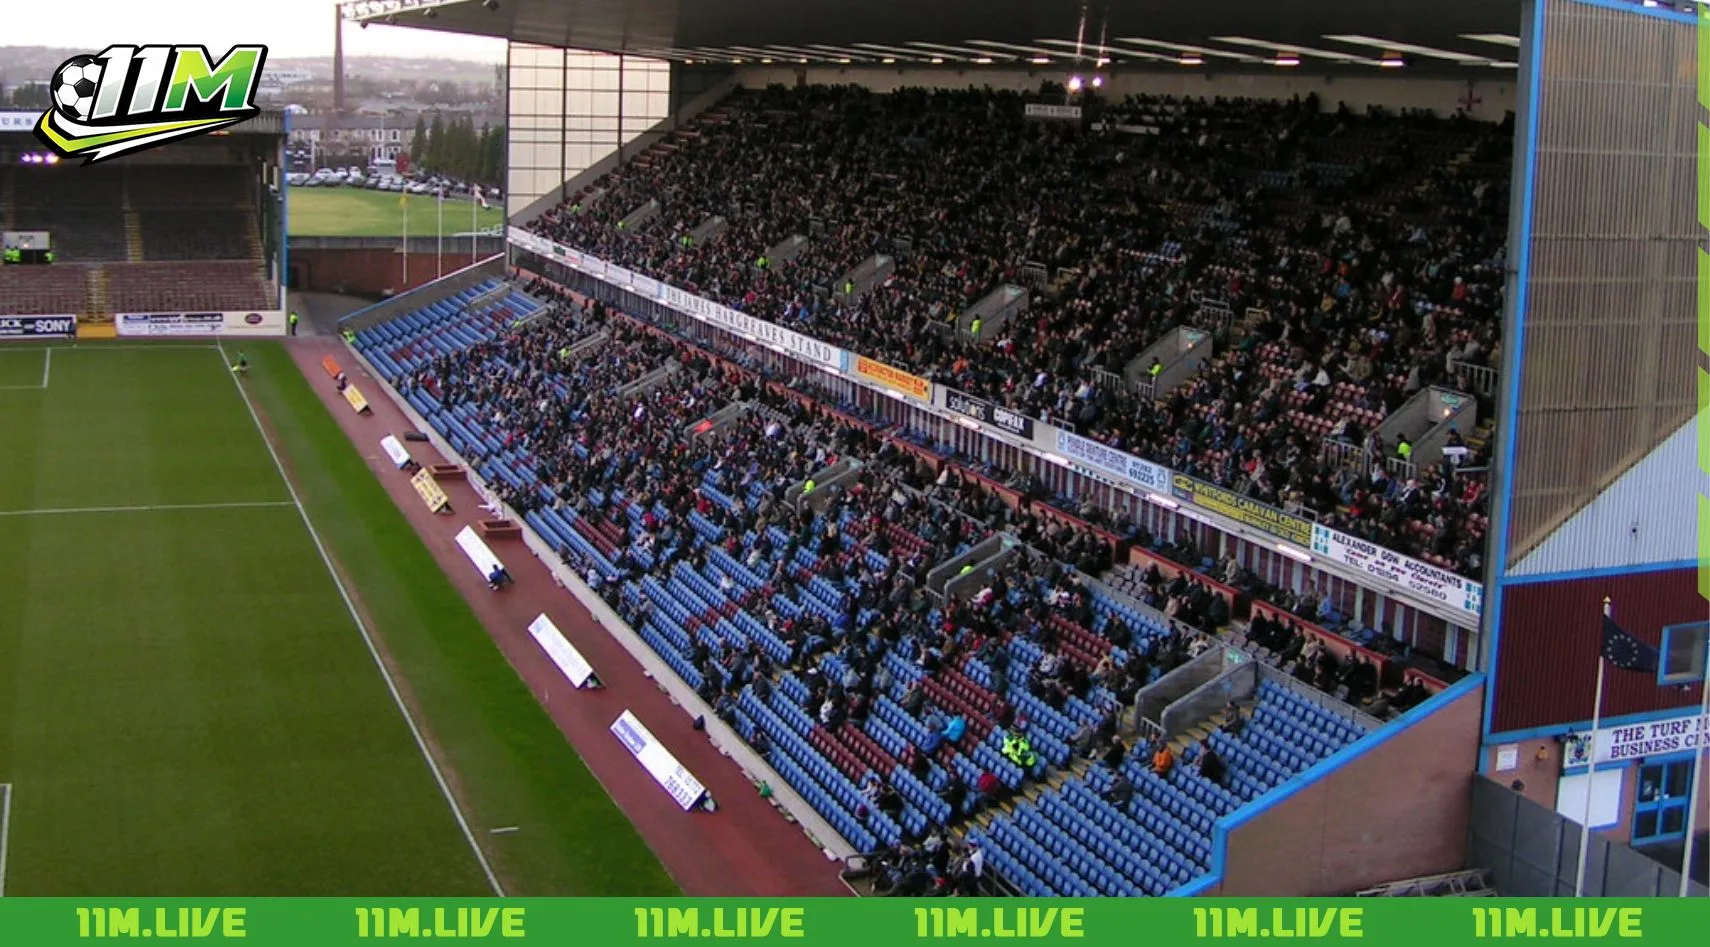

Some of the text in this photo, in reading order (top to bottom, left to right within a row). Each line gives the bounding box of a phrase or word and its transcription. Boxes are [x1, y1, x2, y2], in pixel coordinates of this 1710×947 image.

[35, 319, 70, 332] SONY
[667, 287, 831, 362] THE JAMES HARGREAVES STAND
[1238, 498, 1277, 522] CARAVAN
[1279, 513, 1312, 534] CENTRE
[1332, 533, 1376, 556] ALEXANDER
[1405, 559, 1462, 589] ACCOUNTANTS
[1612, 726, 1645, 743] THE
[1650, 719, 1691, 738] TURF
[1611, 736, 1680, 758] BUSINESS
